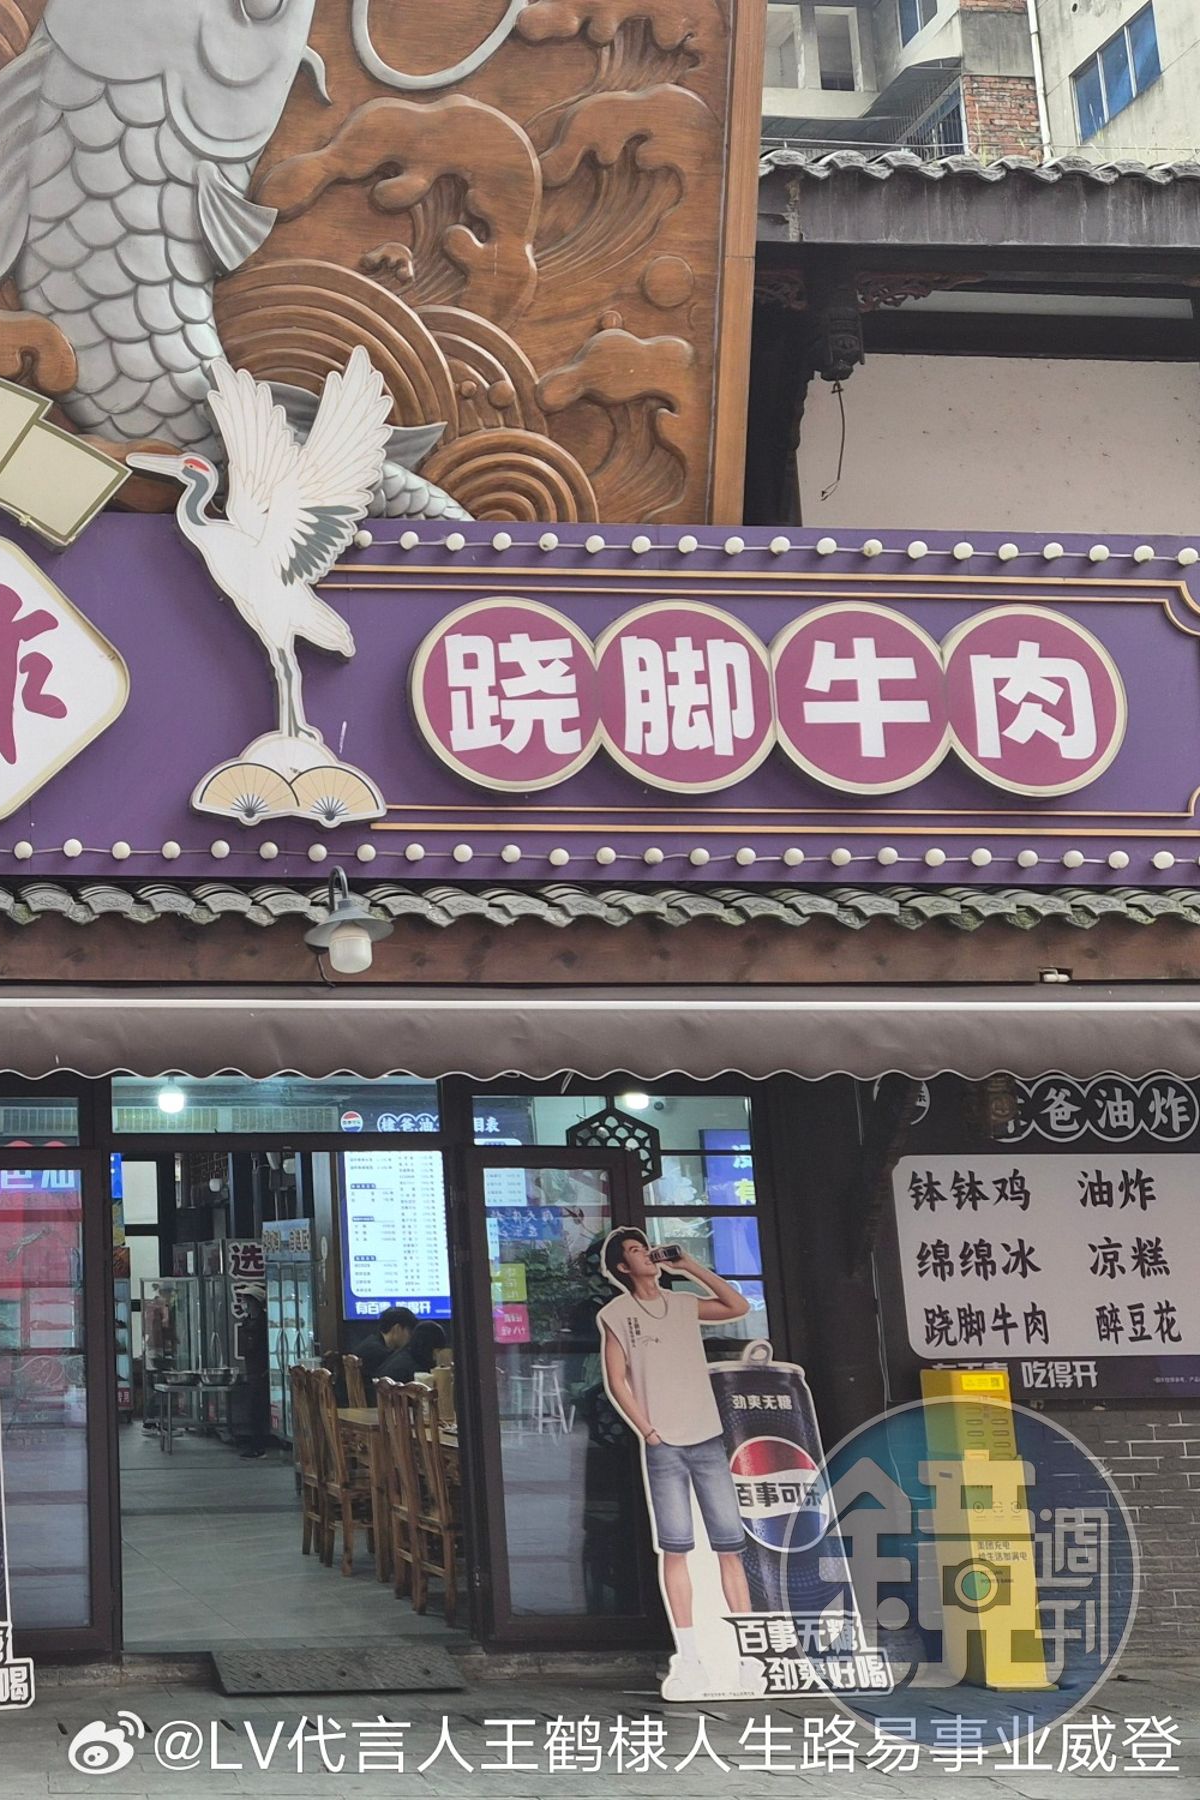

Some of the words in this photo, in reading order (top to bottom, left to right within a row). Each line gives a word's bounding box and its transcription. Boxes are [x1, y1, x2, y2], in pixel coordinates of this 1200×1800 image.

[443, 632, 1099, 761] 跷脚牛肉
[908, 1168, 1032, 1212] 钵钵鸡
[1077, 1168, 1157, 1211] 油炸
[916, 1238, 1042, 1282] 绵绵冰
[1088, 1236, 1171, 1280] 凉糕
[923, 1301, 1050, 1347] 跷脚牛肉
[1096, 1300, 1183, 1345] 醉豆花
[1020, 1360, 1098, 1389] 吃得开
[732, 1394, 793, 1411] 劲爽无糖
[735, 1481, 822, 1508] 百事可乐
[737, 1618, 863, 1654] 百事无糖
[766, 1655, 889, 1691] 劲爽好喝
